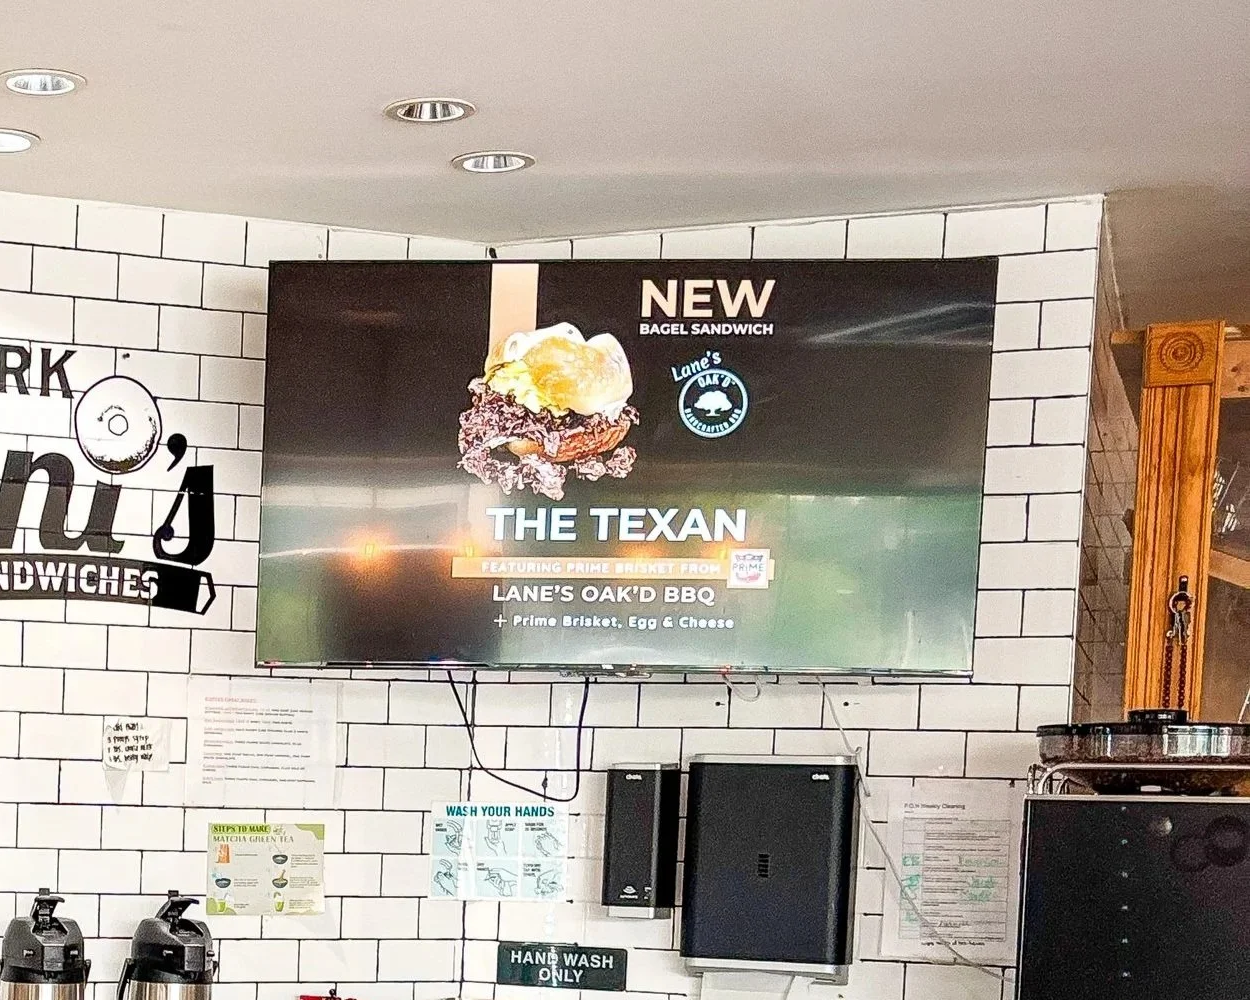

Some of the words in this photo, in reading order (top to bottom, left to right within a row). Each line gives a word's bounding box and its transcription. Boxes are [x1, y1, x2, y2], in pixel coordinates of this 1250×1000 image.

[639, 278, 776, 318] NEW
[639, 323, 689, 336] BAGEL
[690, 323, 774, 336] SANDWICH
[671, 350, 722, 382] Lane's
[485, 507, 578, 541] THE
[589, 508, 747, 542] TEXAN
[481, 561, 562, 574] FEATURING
[566, 562, 610, 574] PRIME
[614, 562, 677, 575] BRISKET
[680, 563, 722, 575] FROM
[731, 562, 765, 573] PRIME
[492, 584, 574, 603] LANE'S
[581, 585, 658, 604] OAK'D
[663, 586, 716, 607] BBQ
[513, 614, 558, 628] Prime
[562, 615, 623, 629] Brisket,
[628, 615, 658, 631] Egg
[662, 616, 674, 629] &
[678, 616, 735, 630] Cheese
[445, 805, 478, 817] WASH
[481, 805, 511, 817] YOUR
[515, 805, 555, 817] HANDS
[213, 825, 236, 833] STEPS
[238, 825, 247, 833] TO
[249, 825, 268, 833] MAKE
[510, 950, 559, 965] HAND
[563, 953, 614, 969] WASH
[538, 967, 584, 983] ONLY
